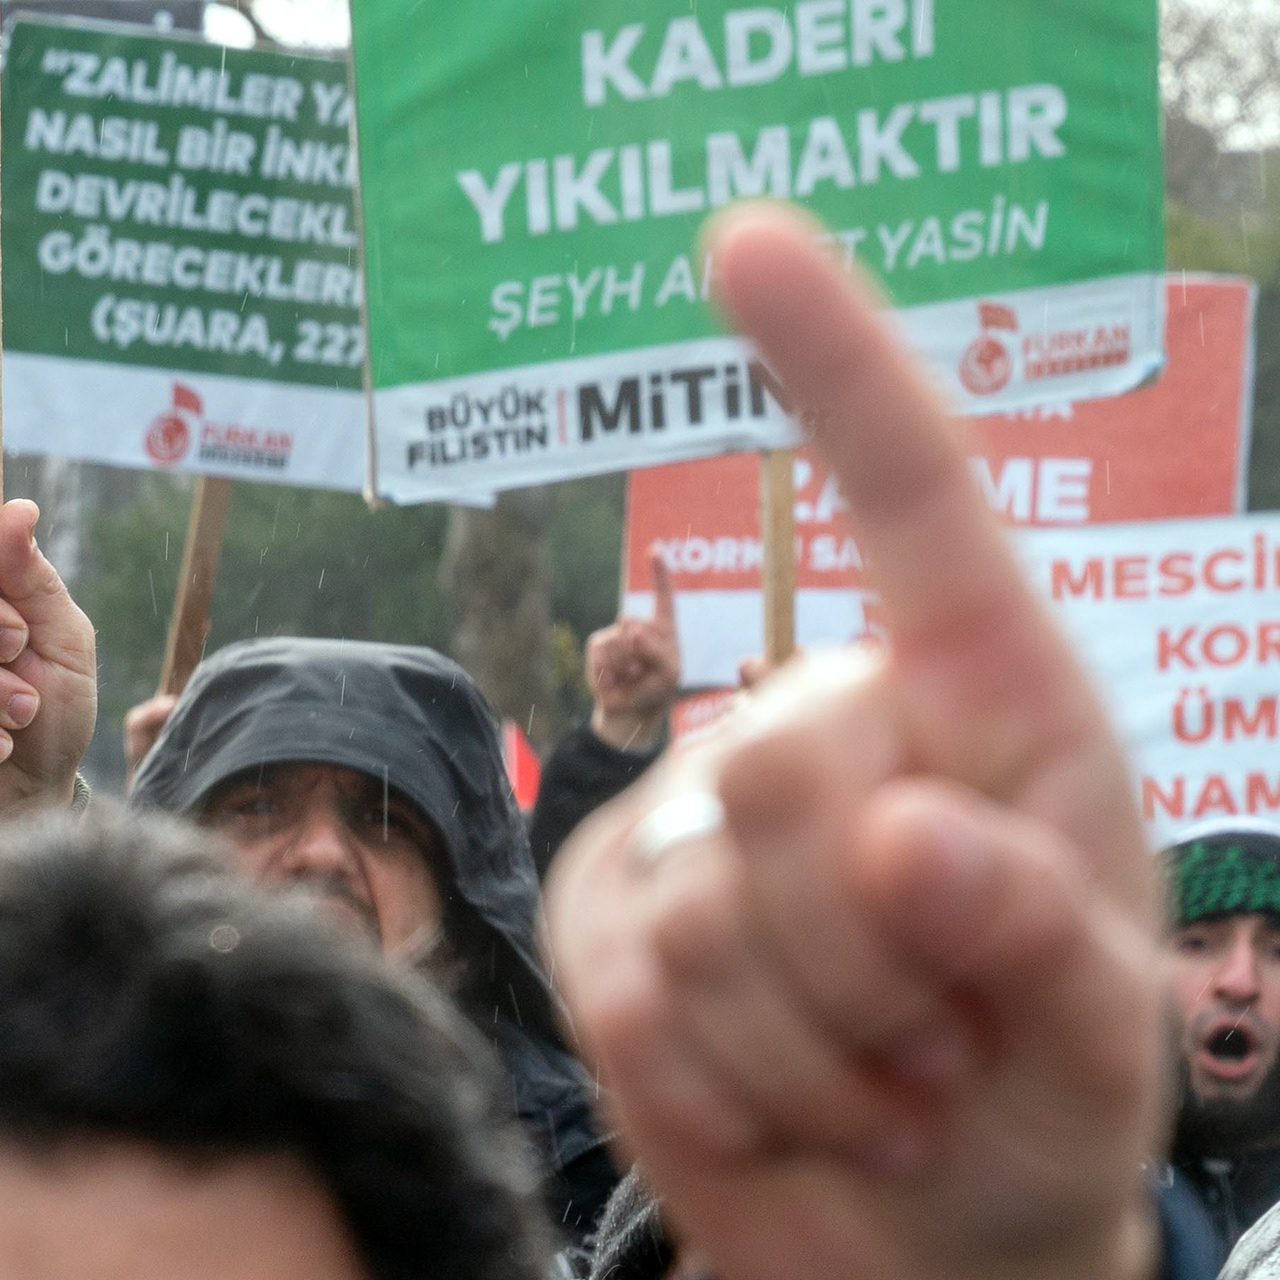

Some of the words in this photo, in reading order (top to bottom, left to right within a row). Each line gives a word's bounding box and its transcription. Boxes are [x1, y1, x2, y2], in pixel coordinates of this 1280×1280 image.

[23, 107, 170, 166] NASIL
[176, 117, 257, 177] BİR
[458, 82, 1069, 244] YIKILMAKTIR
[487, 260, 647, 341] ŞEYH
[877, 194, 1049, 270] YASİN
[91, 293, 285, 367] (ŞUARA,
[425, 382, 548, 434] BÜYÜK
[1048, 531, 1280, 602] MESCİ
